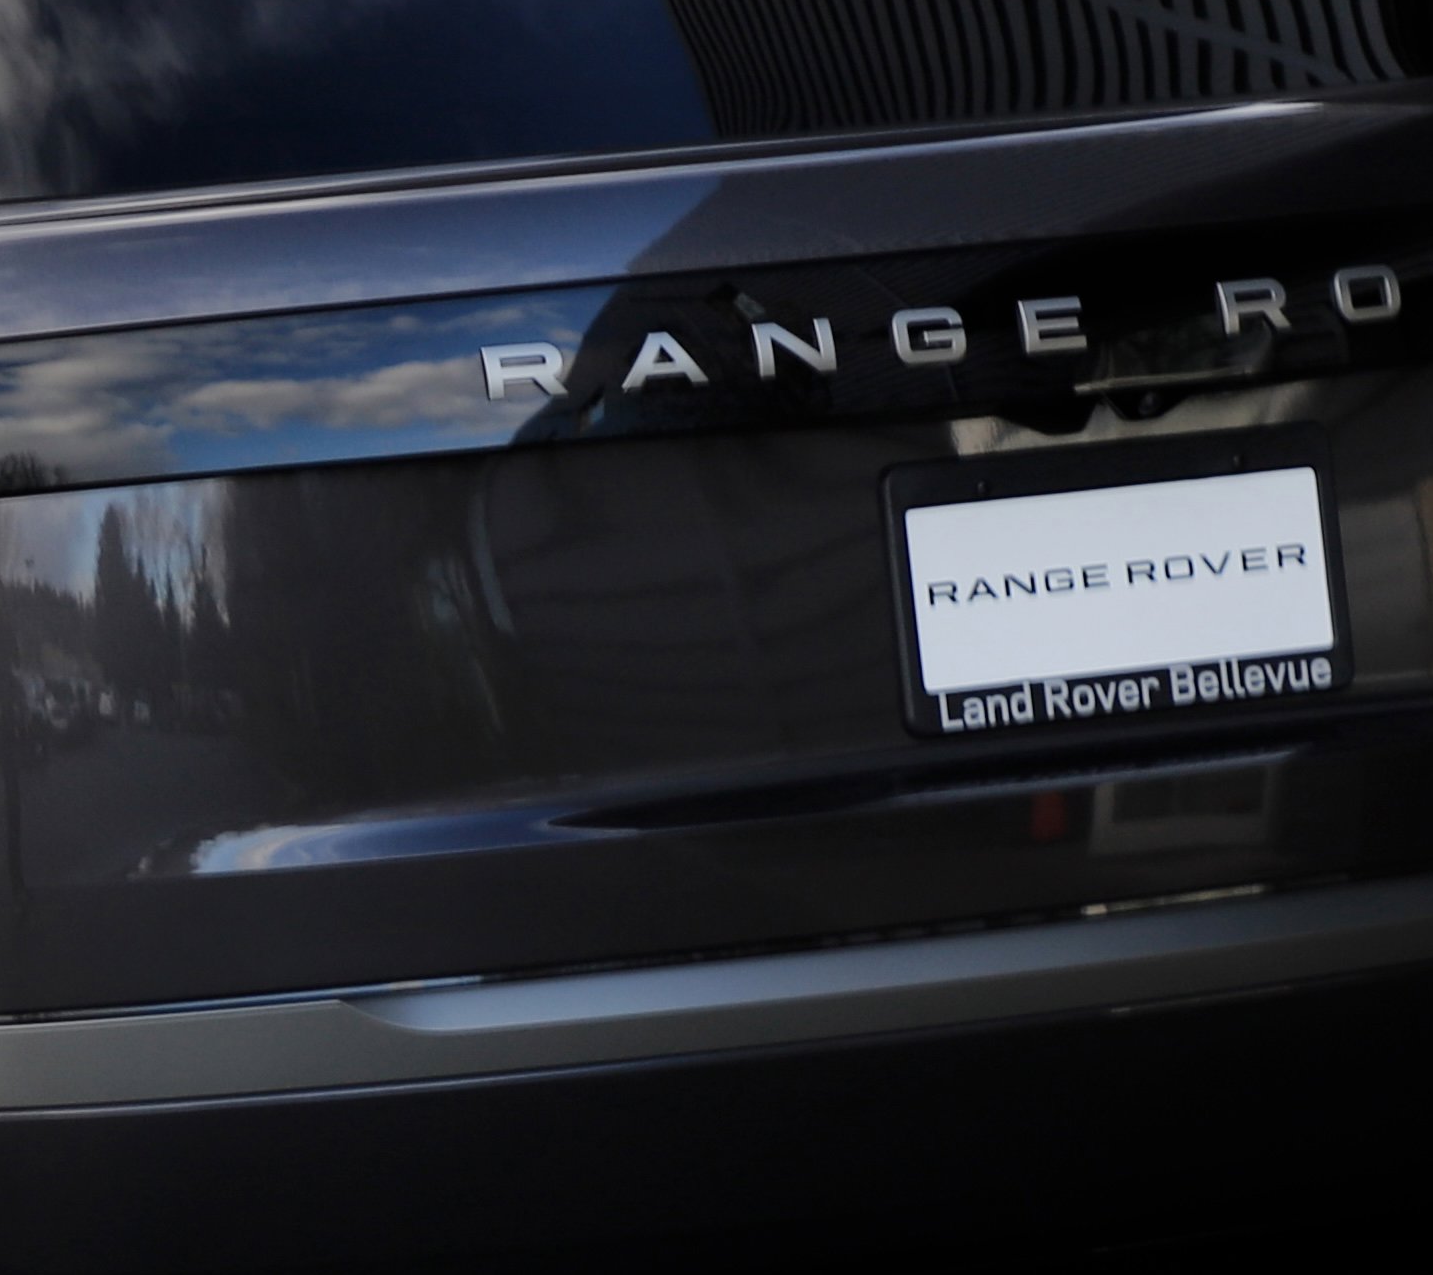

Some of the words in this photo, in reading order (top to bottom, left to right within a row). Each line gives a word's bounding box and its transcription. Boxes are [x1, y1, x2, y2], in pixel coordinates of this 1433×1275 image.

[480, 295, 1088, 401] RANGE
[927, 562, 1112, 608] RANGE
[1125, 542, 1308, 587] ROVER
[937, 679, 1034, 733] Land
[1044, 677, 1160, 720] Rover
[1169, 655, 1332, 706] Bellevue
